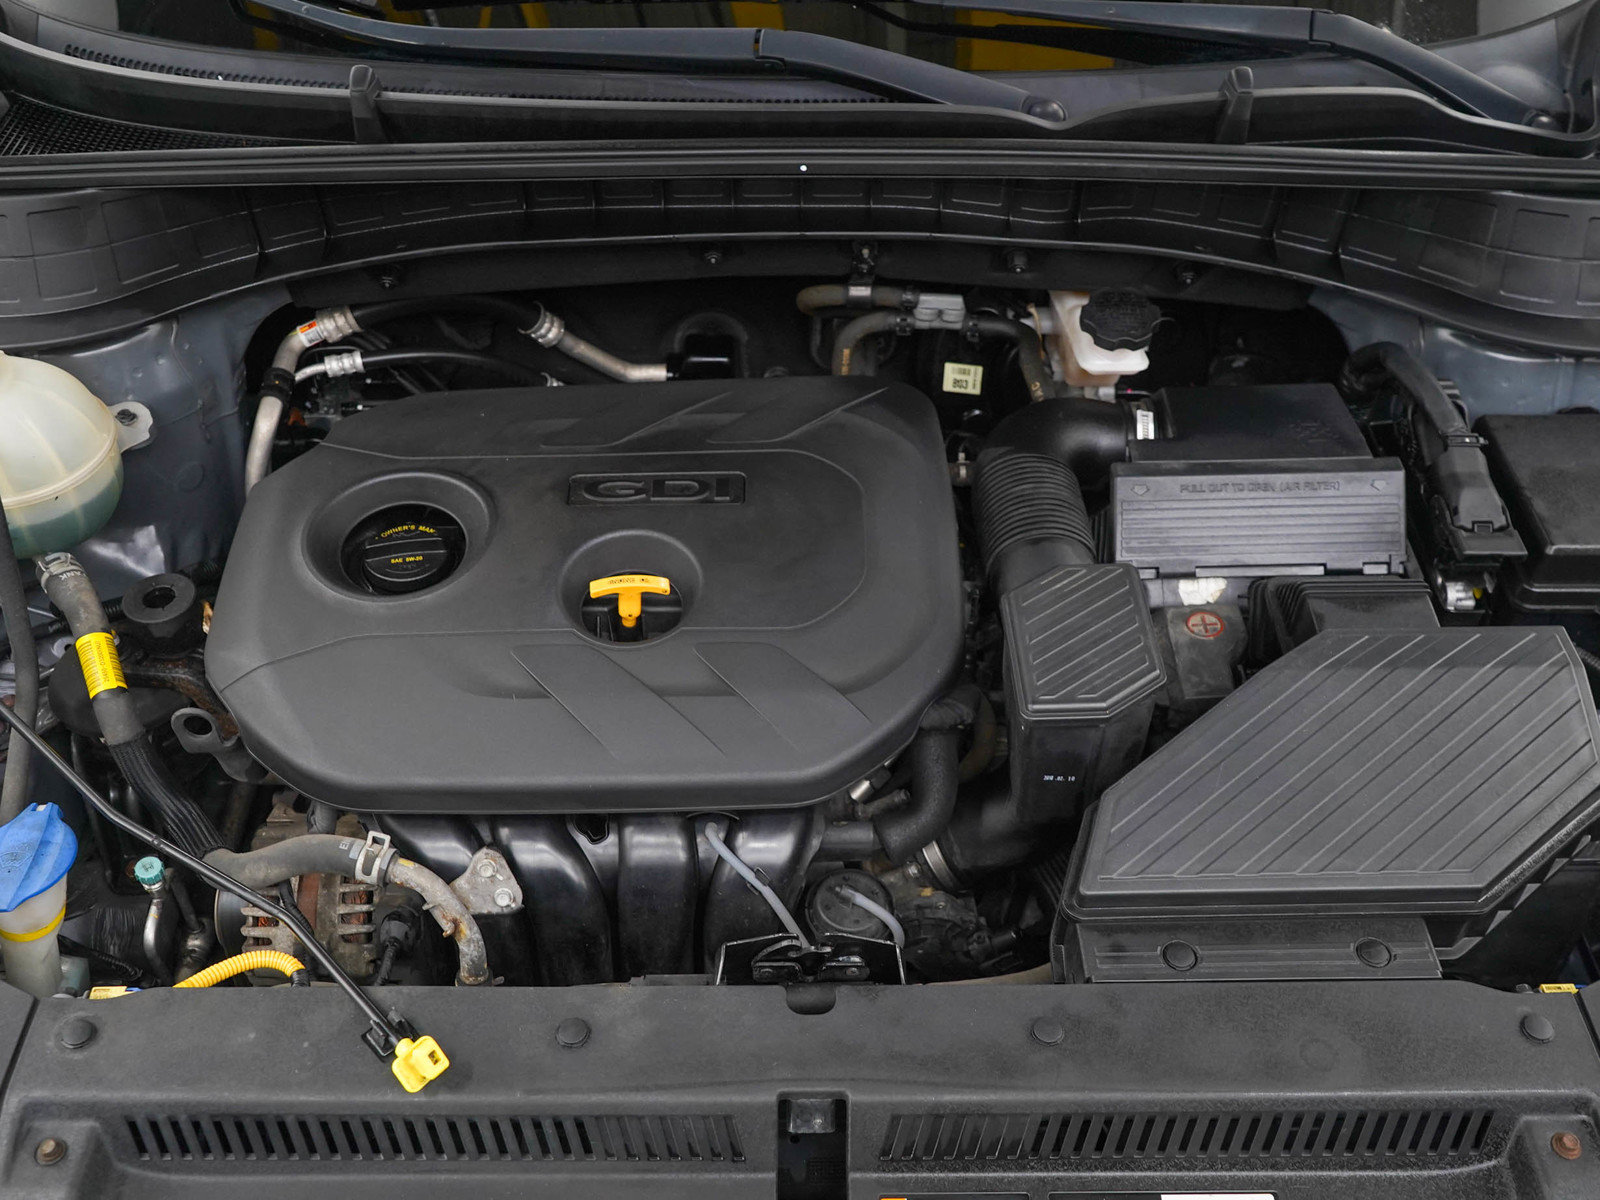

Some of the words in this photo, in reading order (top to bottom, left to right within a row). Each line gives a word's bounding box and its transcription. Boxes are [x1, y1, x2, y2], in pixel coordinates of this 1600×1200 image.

[582, 478, 730, 501] GDI
[1180, 483, 1206, 494] PULL
[1209, 483, 1230, 493] OUT
[1232, 483, 1246, 493] TO
[1248, 482, 1276, 493] OPEN
[1303, 480, 1341, 492] FILTER)
[381, 525, 416, 538] OWNER'S
